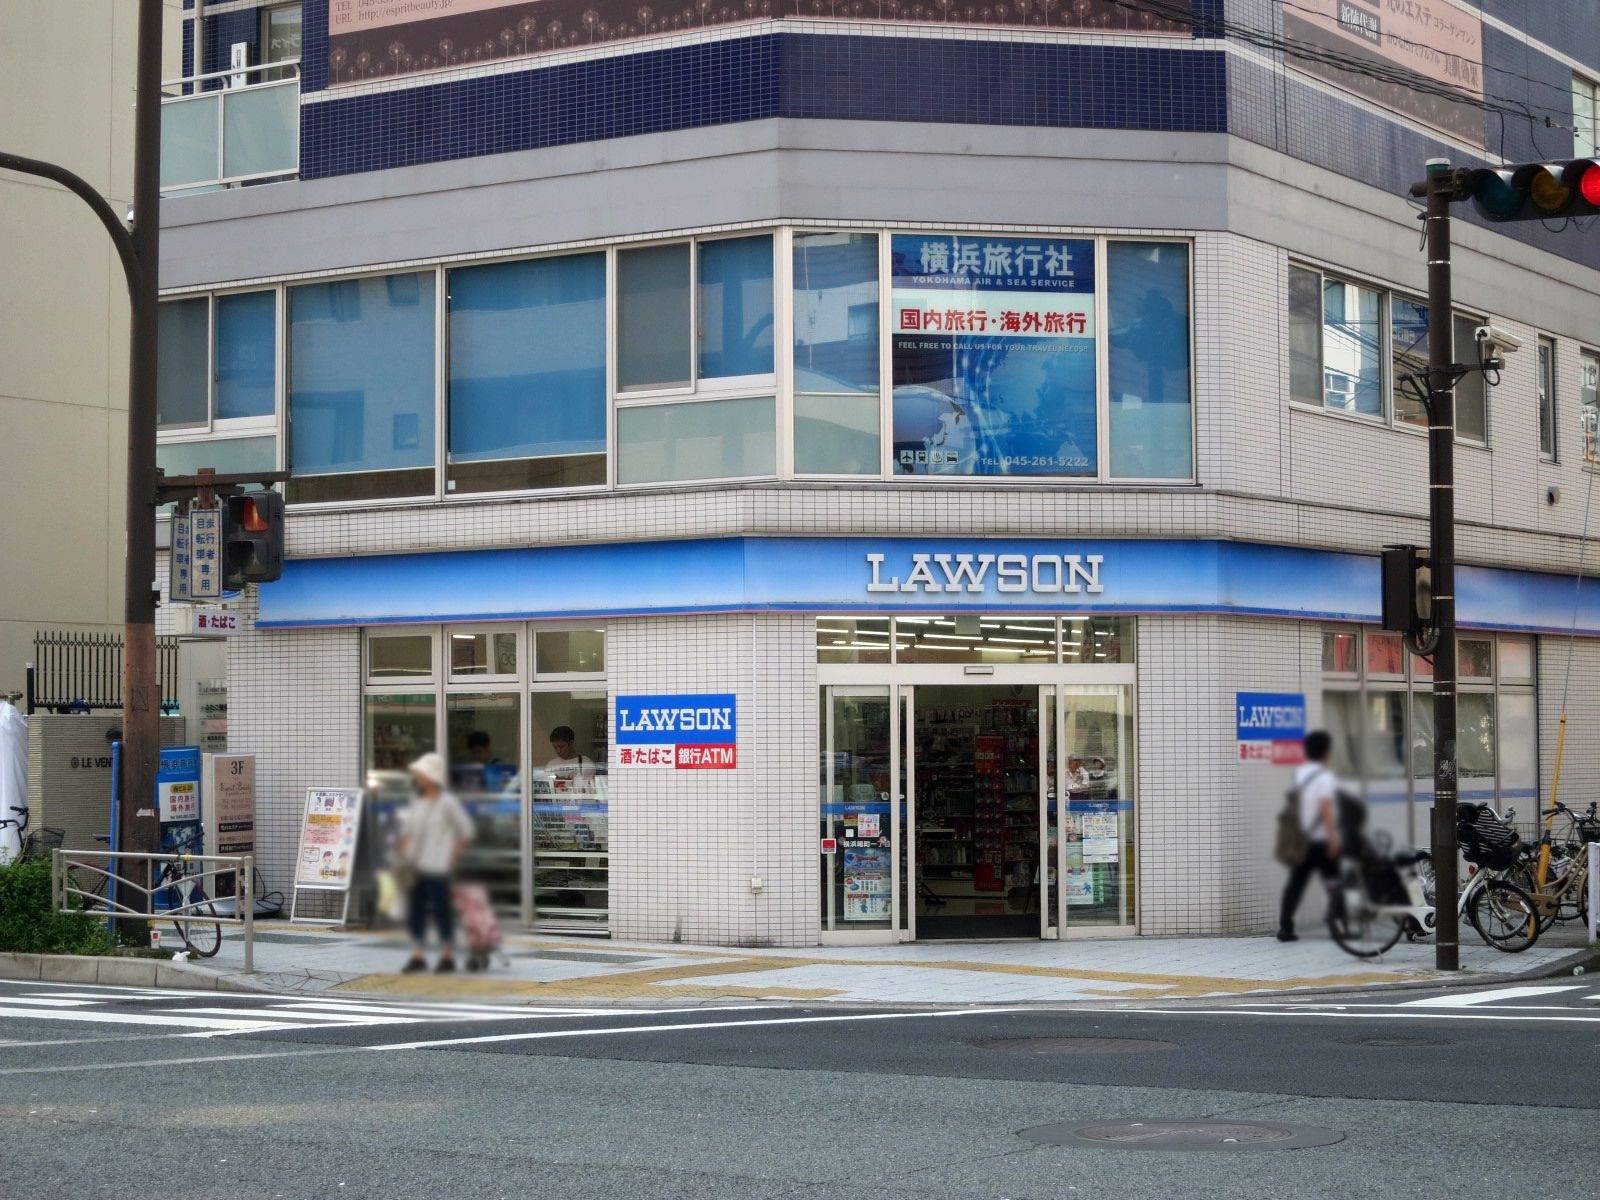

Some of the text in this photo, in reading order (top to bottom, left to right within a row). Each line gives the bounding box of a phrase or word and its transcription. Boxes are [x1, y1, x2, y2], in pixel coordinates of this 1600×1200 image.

[335, 1, 352, 12] TEL
[335, 15, 353, 25] URL
[920, 241, 1075, 277] 横浜旅行社
[912, 276, 971, 285] YOKOHAMA
[975, 278, 992, 286] AIR
[1030, 279, 1075, 288] SERVICE
[898, 341, 918, 349] FEEL
[919, 342, 939, 350] FREE
[940, 342, 952, 350] TO
[974, 343, 985, 351] US
[987, 343, 1003, 351] FOR
[1004, 343, 1026, 351] YOUR
[1027, 344, 1057, 353] TRAVEL
[1005, 456, 1090, 467] 045-261-5222
[867, 553, 1104, 593] LAWSON
[620, 708, 732, 731] LAWSON
[82, 757, 92, 768] LE
[678, 748, 733, 765] 銀行ATM
[231, 761, 244, 775] 3F
